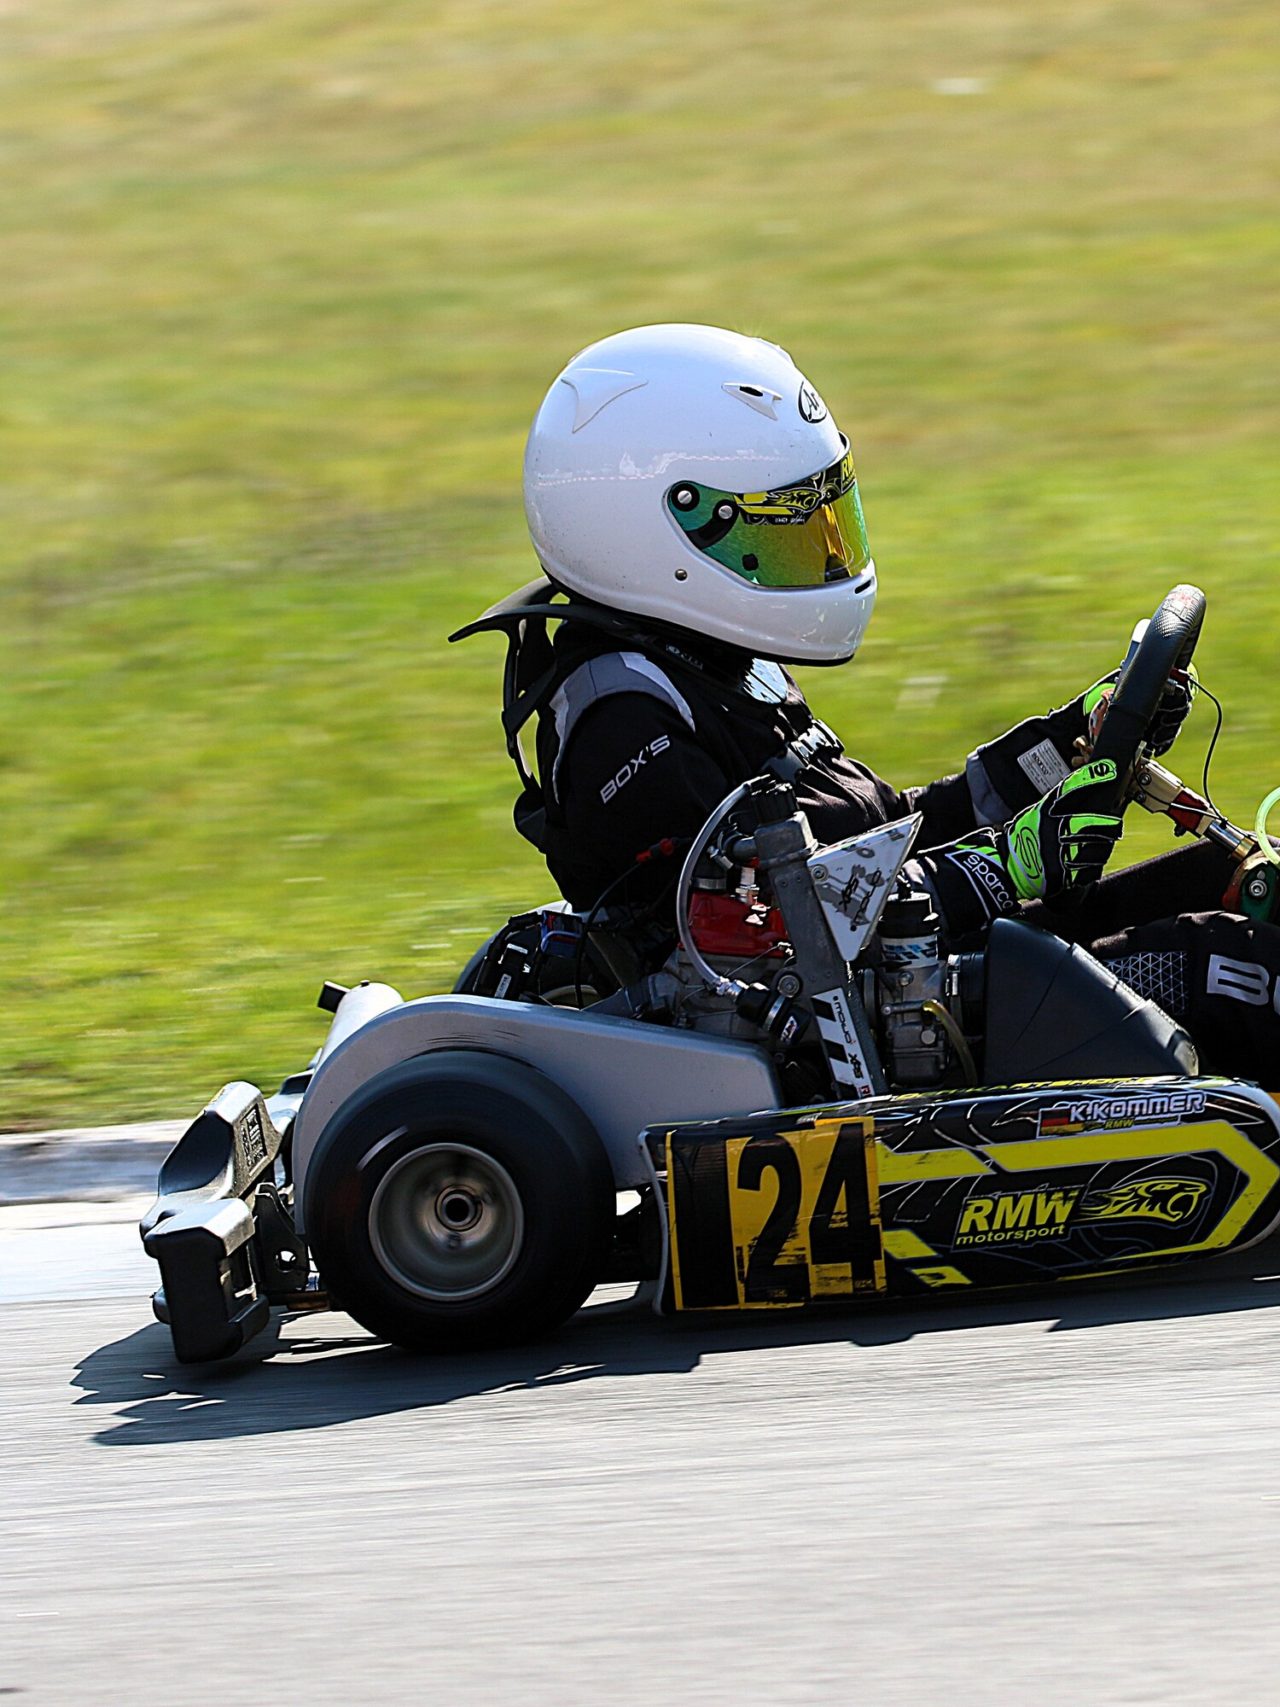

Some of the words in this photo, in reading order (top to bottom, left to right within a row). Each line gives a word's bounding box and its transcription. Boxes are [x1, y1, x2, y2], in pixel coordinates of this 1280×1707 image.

[599, 734, 671, 804] BOX'S
[963, 854, 1014, 910] sparco
[956, 1221, 1066, 1246] motorsport
[960, 1189, 1078, 1230] RMW
